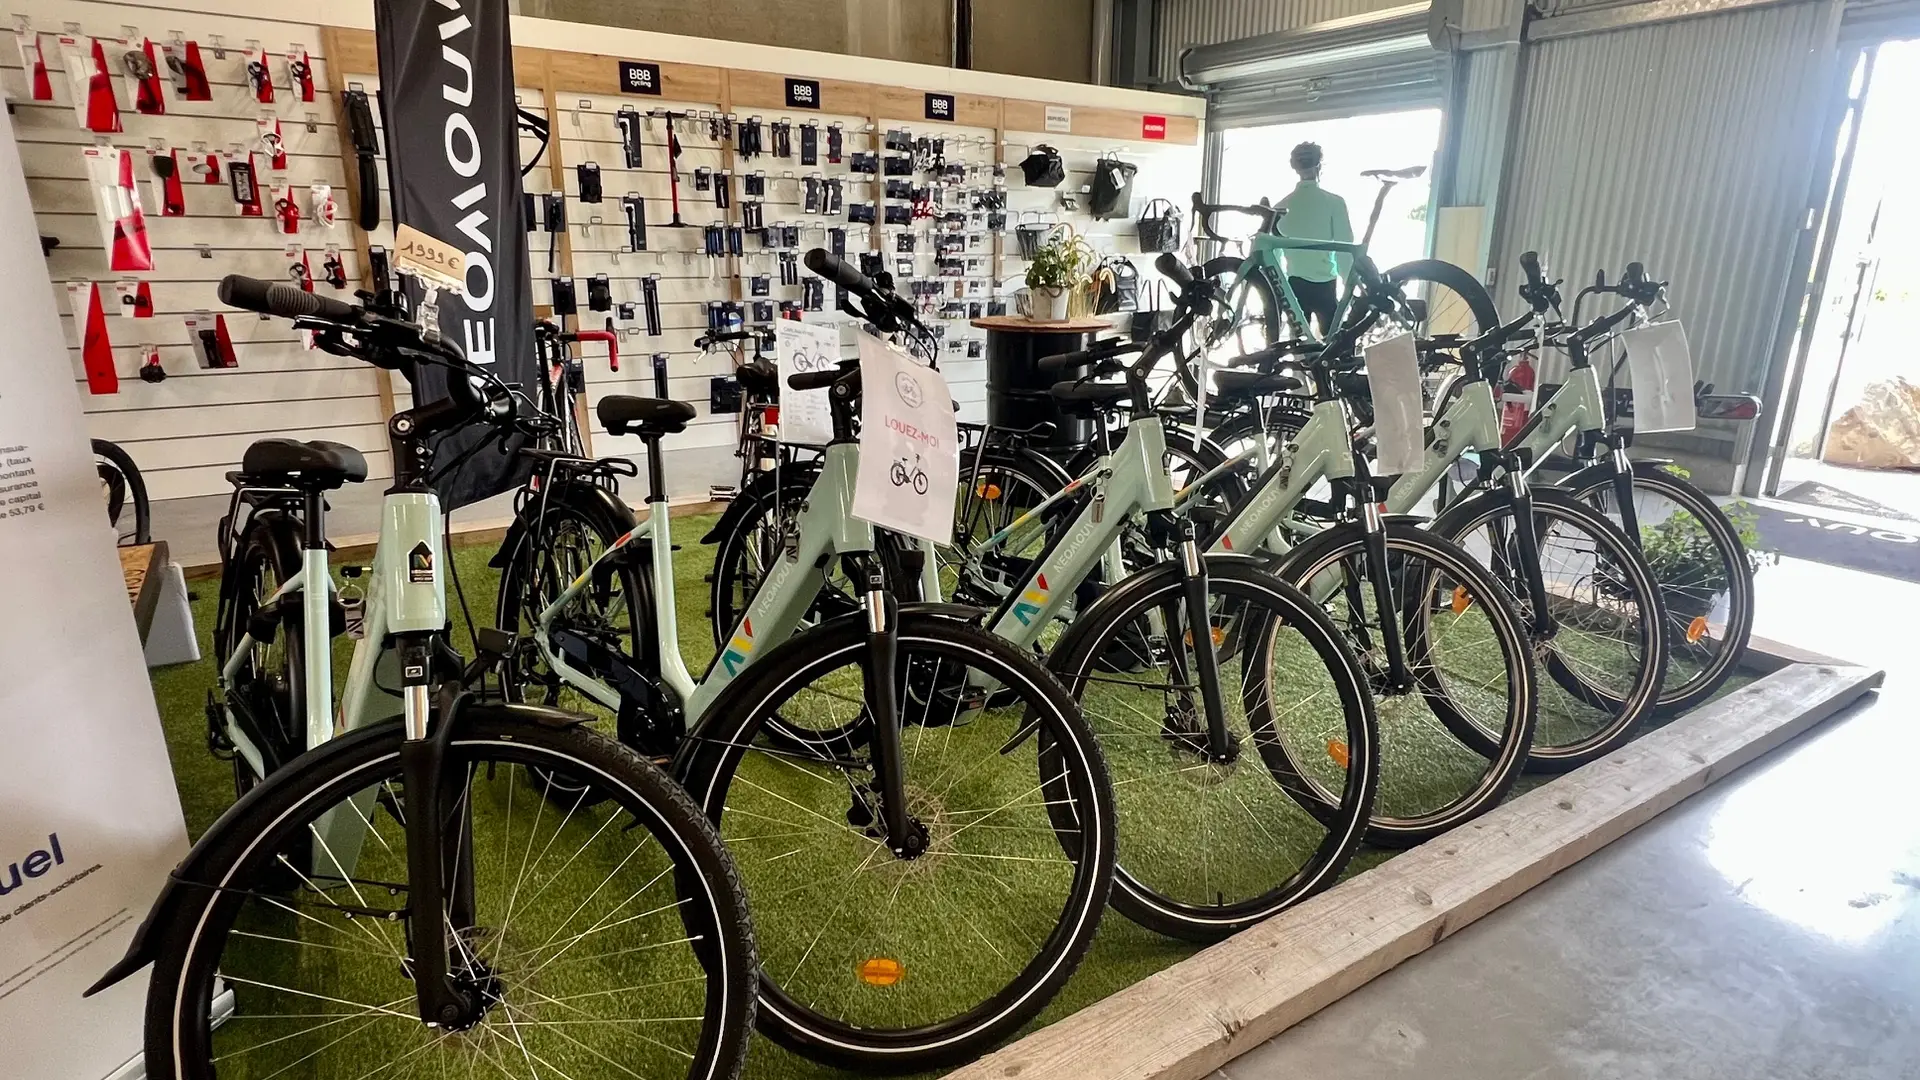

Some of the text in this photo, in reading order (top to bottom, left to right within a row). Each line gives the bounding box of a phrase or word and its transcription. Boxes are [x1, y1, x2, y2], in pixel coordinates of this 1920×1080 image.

[629, 68, 651, 80] BBB
[630, 80, 652, 88] cycling
[793, 84, 812, 96] BBB
[932, 98, 948, 110] BBB
[400, 241, 460, 270] 1999 €
[884, 414, 940, 449] LOUEZ-MOI
[6, 456, 32, 467] (taux
[8, 491, 42, 504] capital
[8, 504, 36, 517] 53,79
[37, 502, 45, 511] €
